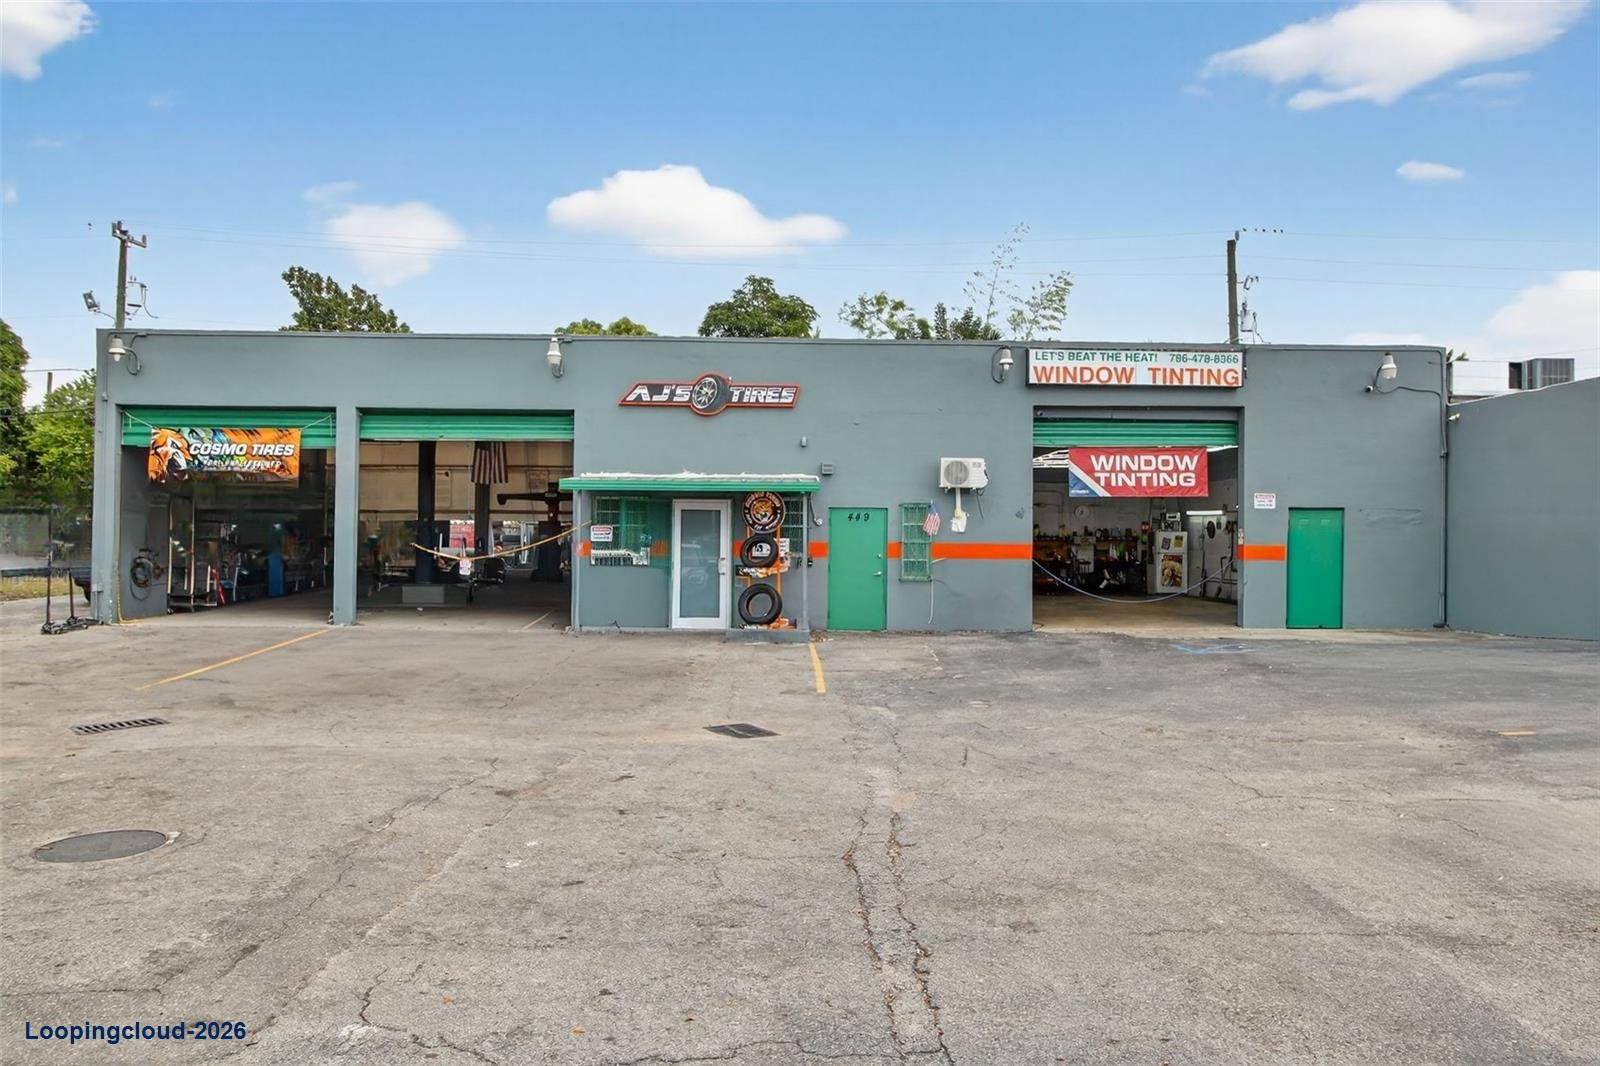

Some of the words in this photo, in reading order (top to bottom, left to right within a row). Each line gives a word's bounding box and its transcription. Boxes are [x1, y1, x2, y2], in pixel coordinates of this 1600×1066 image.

[1035, 351, 1065, 361] LET'S
[1068, 351, 1096, 361] BEAT
[1100, 352, 1122, 362] THE
[1125, 352, 1158, 362] HEAT!
[1033, 366, 1135, 384] WINDOW
[1147, 367, 1240, 386] TINTING
[625, 384, 693, 402] AJ'S
[729, 386, 797, 403] TIRES
[189, 443, 248, 456] COSMO
[251, 443, 295, 456] TIRES
[1090, 454, 1199, 471] WINDOW
[1094, 472, 1196, 487] TINTING
[848, 512, 870, 522] 449
